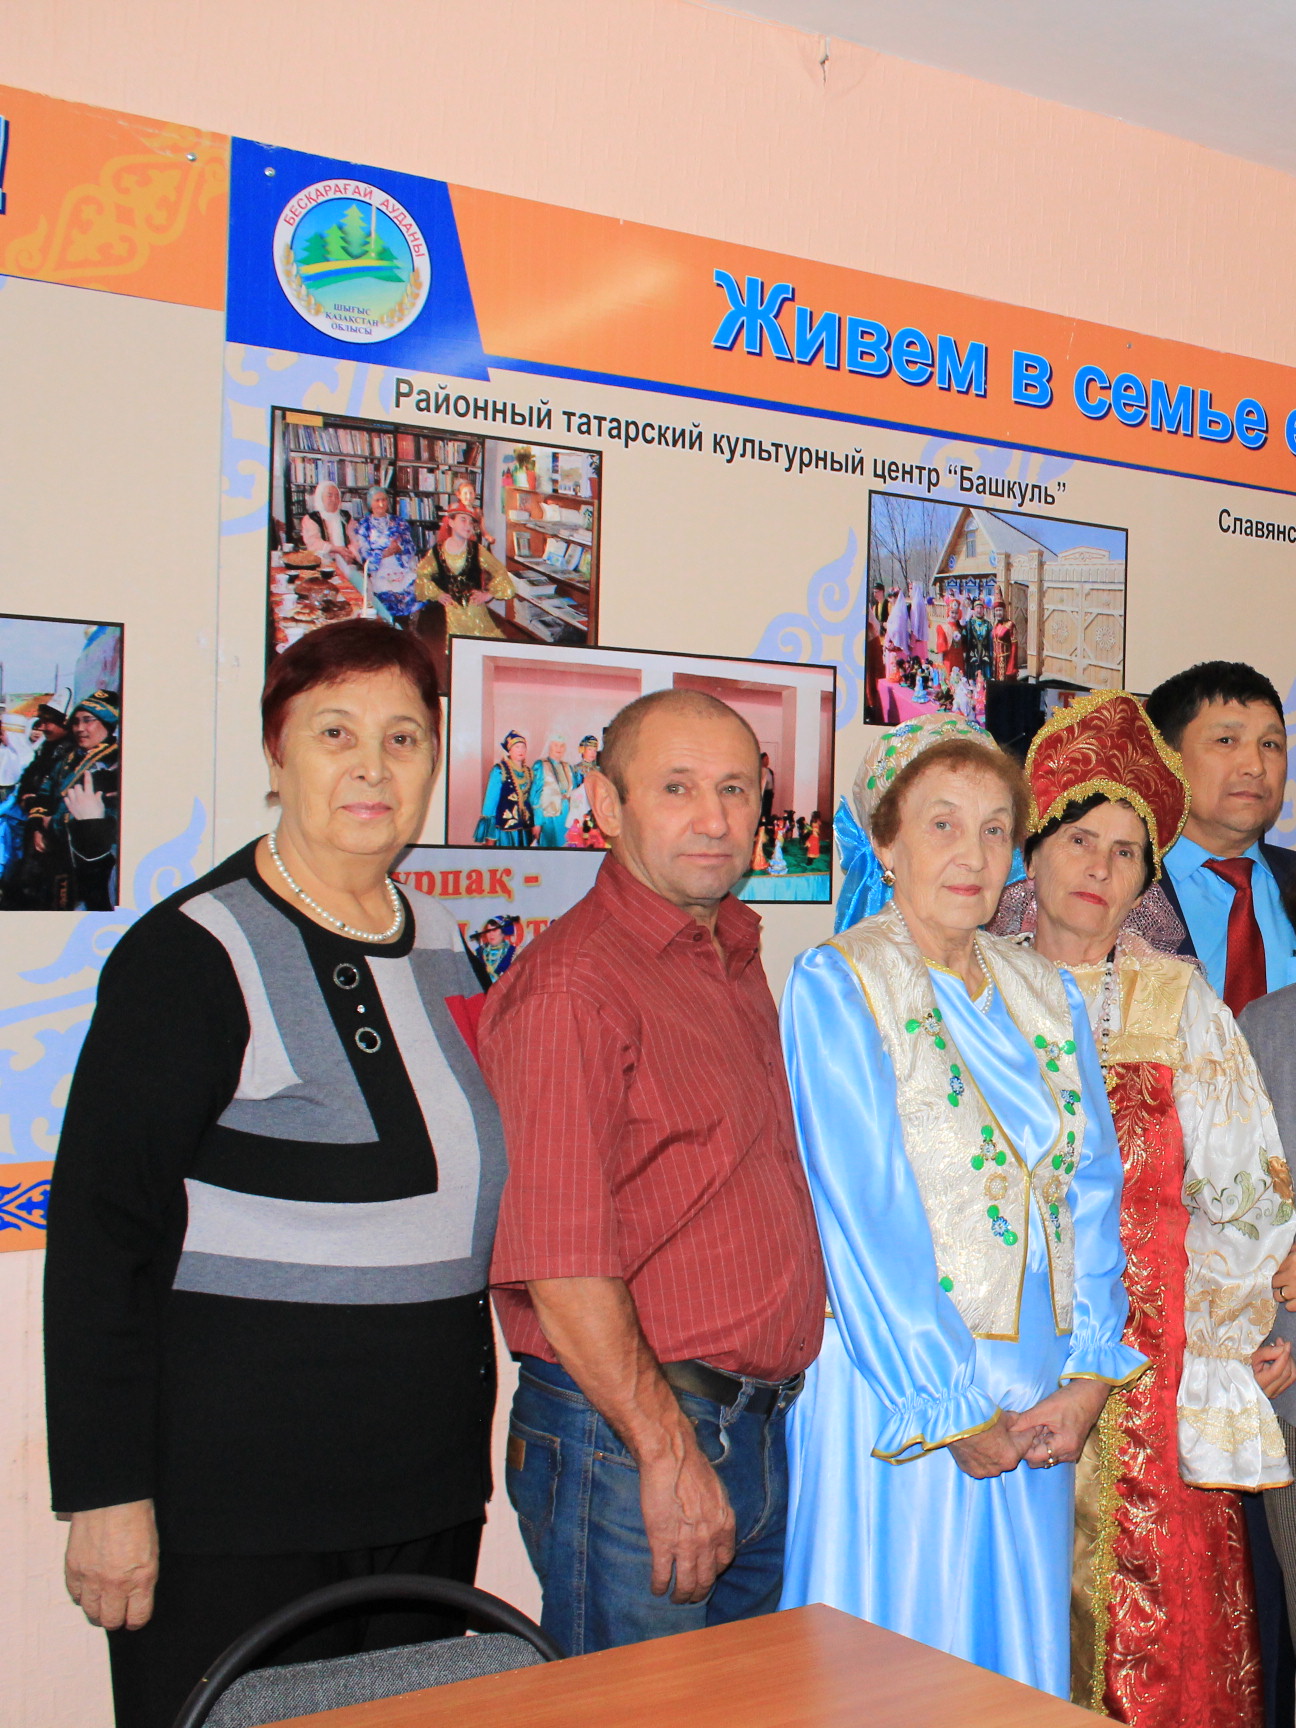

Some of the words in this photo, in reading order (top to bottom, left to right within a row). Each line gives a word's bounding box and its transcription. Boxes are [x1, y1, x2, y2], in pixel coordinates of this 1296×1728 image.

[283, 183, 375, 227] БЕСҚАРАҒАЙ
[379, 198, 426, 257] АУДАНЫ
[330, 322, 373, 336] ОБЛЫСЫ
[333, 303, 372, 316] ШЫҒЫС
[711, 268, 988, 398] Живем
[1011, 350, 1053, 408] в
[1073, 365, 1267, 449] семье
[394, 378, 551, 430] Районный
[562, 410, 703, 453] татарский
[713, 432, 864, 476] культурный
[872, 457, 940, 493] центр
